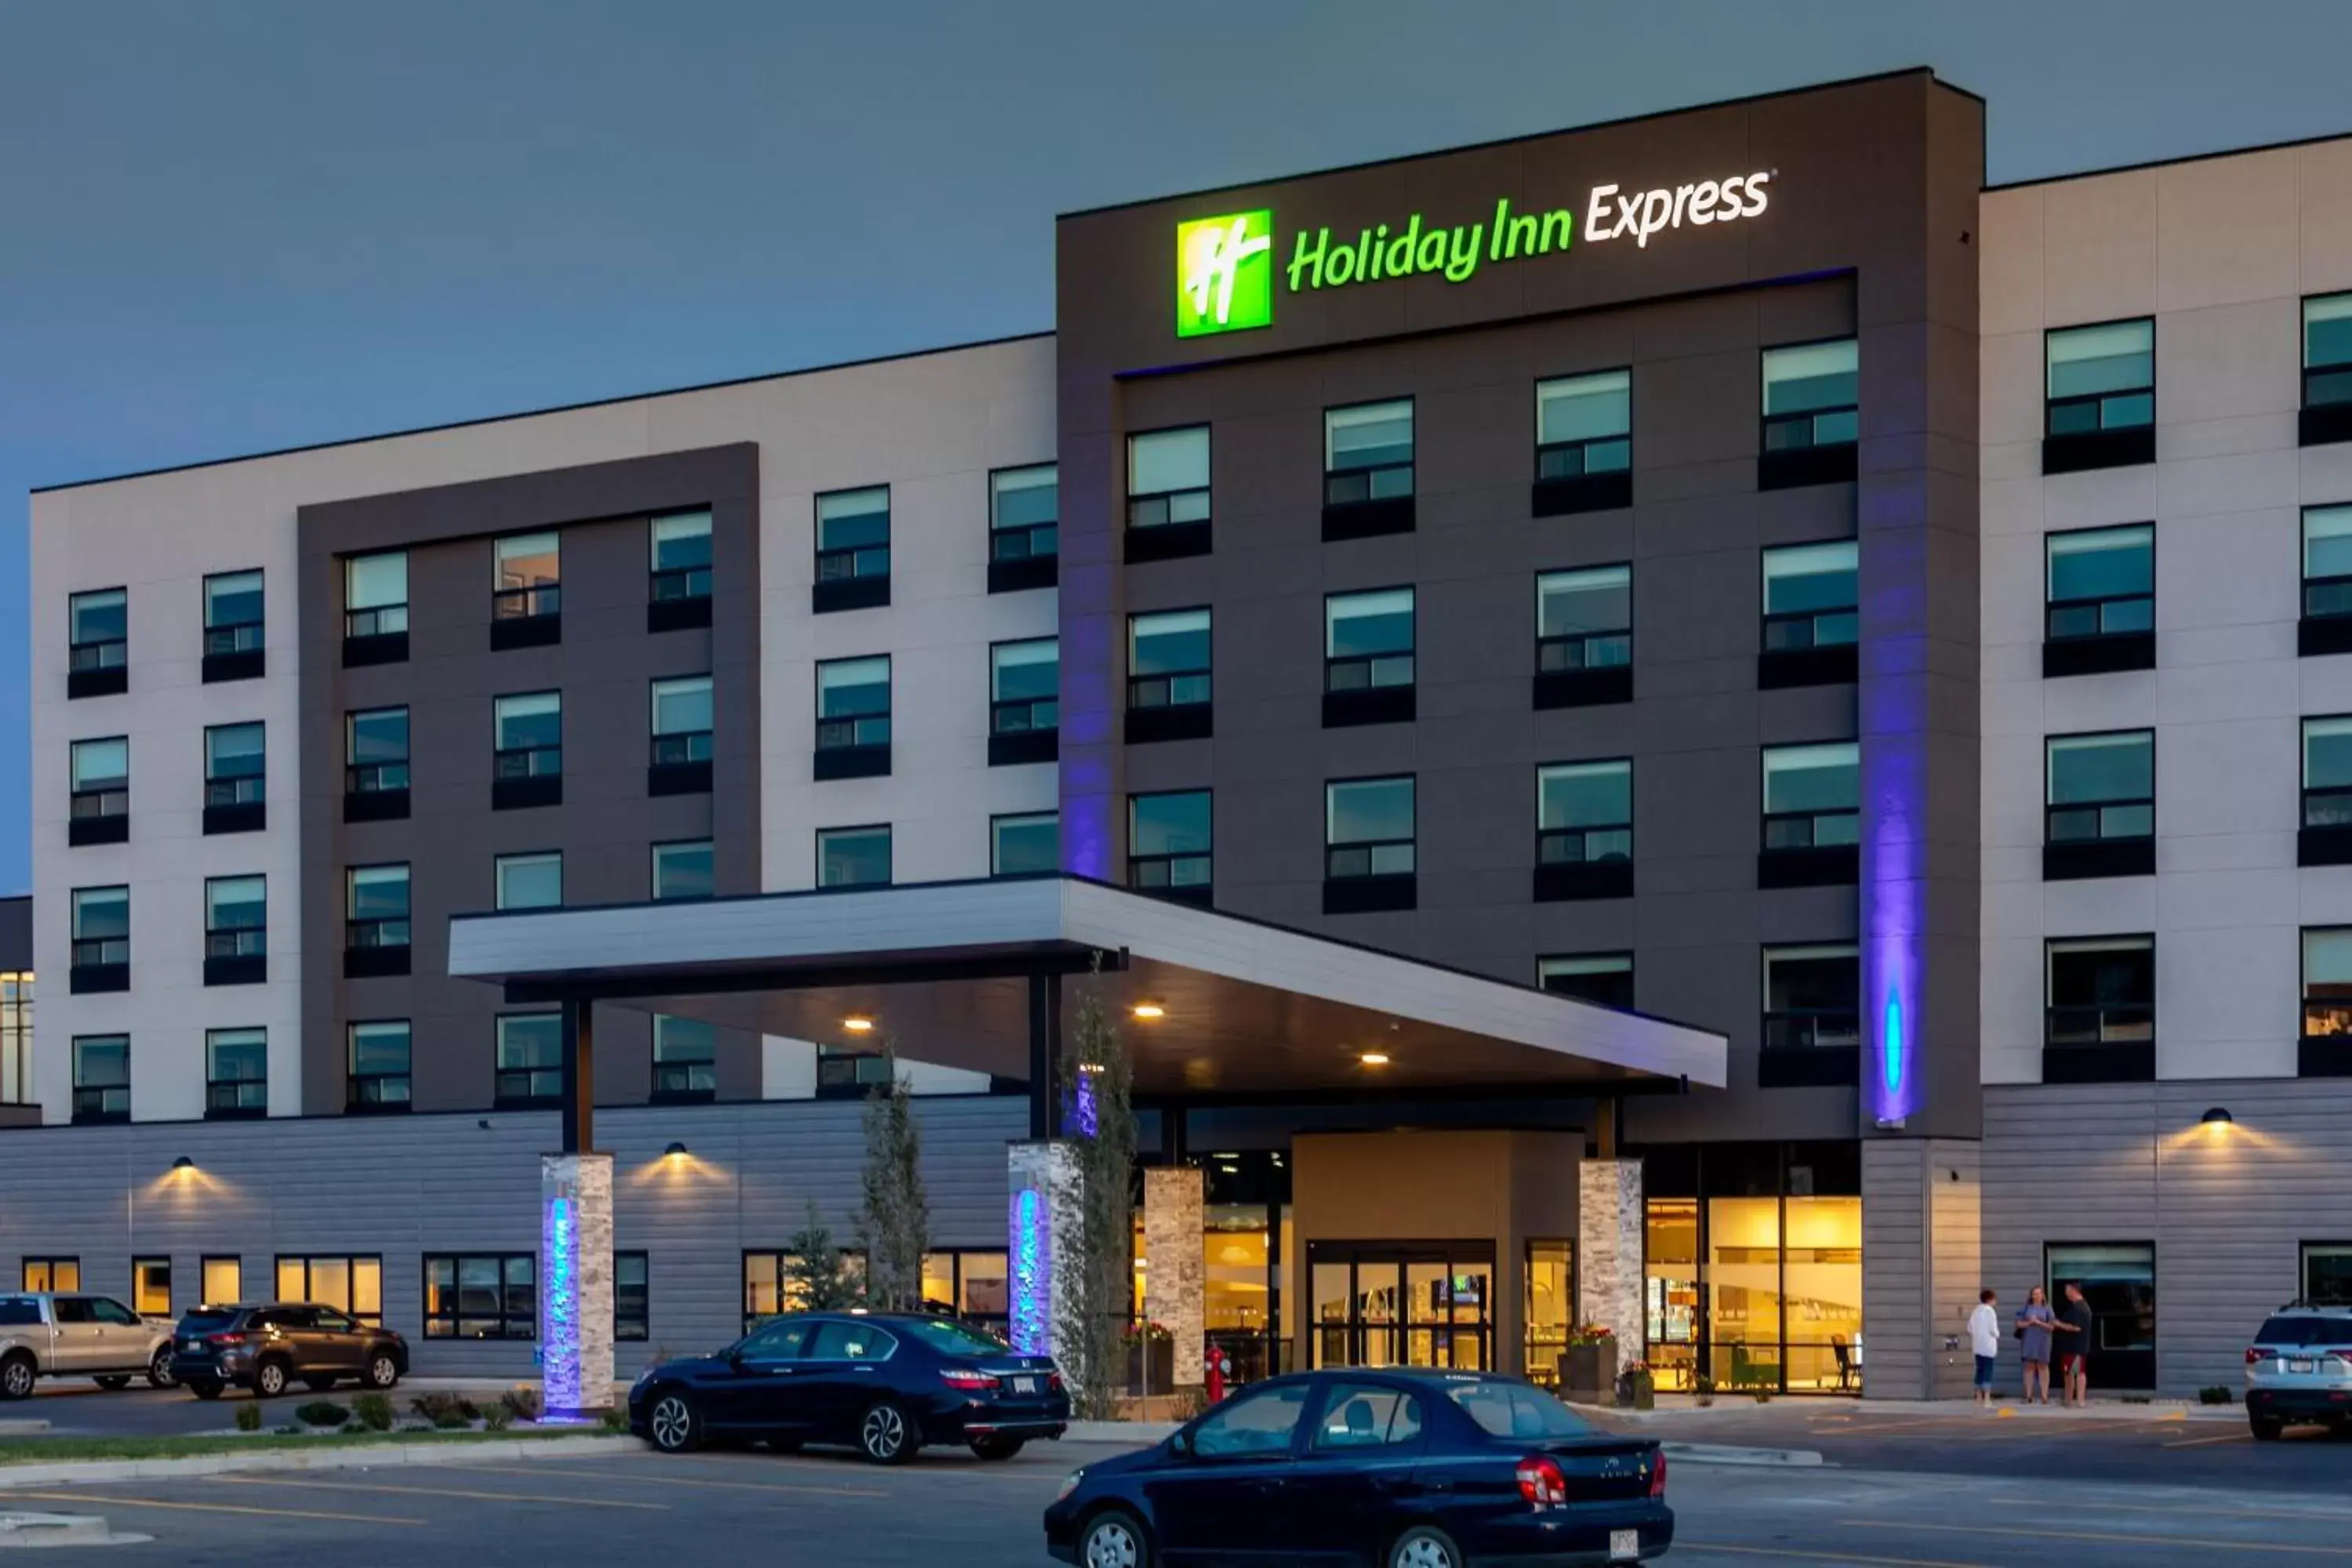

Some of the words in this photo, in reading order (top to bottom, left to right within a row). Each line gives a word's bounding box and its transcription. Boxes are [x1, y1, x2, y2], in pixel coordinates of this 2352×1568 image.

[1286, 213, 1483, 292] Holiday
[1489, 198, 1573, 261] Inn
[1584, 171, 1770, 249] Express
